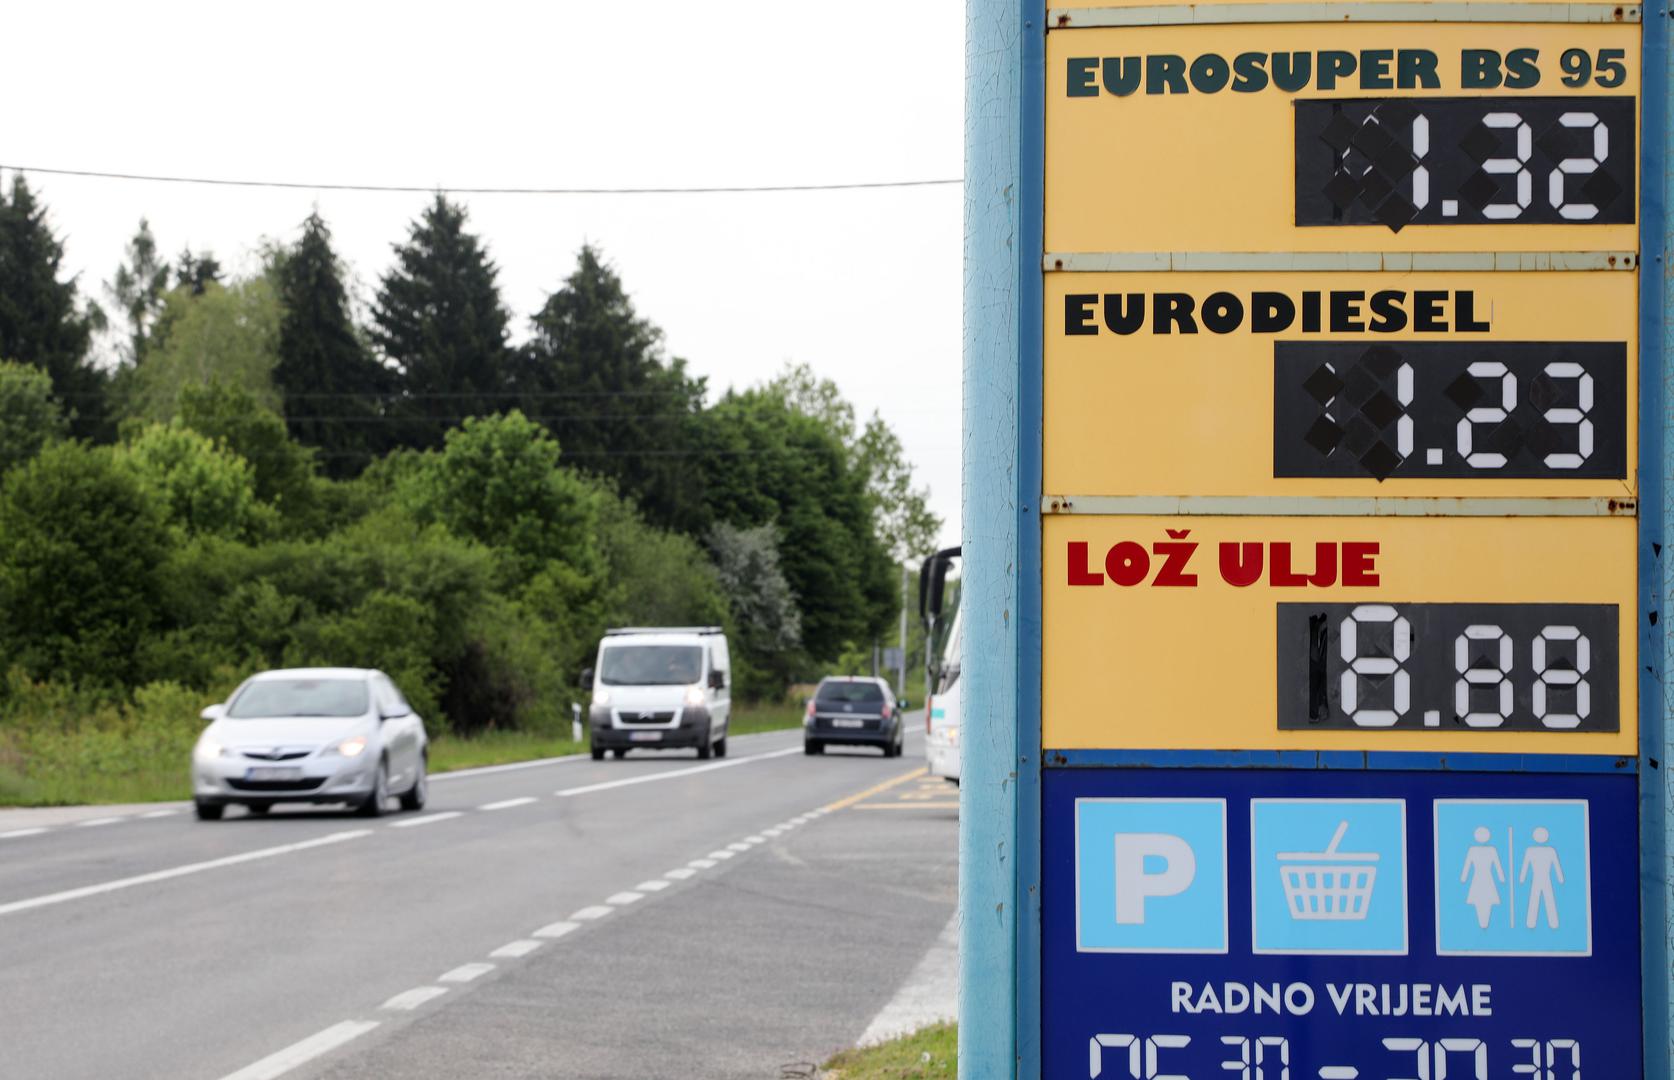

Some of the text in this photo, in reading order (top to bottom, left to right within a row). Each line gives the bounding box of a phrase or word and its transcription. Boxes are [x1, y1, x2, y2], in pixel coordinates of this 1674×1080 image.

[1067, 48, 1626, 97] EUROSUPER BS 95
[1413, 113, 1608, 219] 1.32
[1065, 290, 1490, 335] EURODIESEL
[1398, 363, 1593, 468] 1.23
[1068, 530, 1379, 587] LOŽ ULJE
[1341, 605, 1590, 728] 8.88
[1172, 981, 1492, 1016] RADNO VRIJEME
